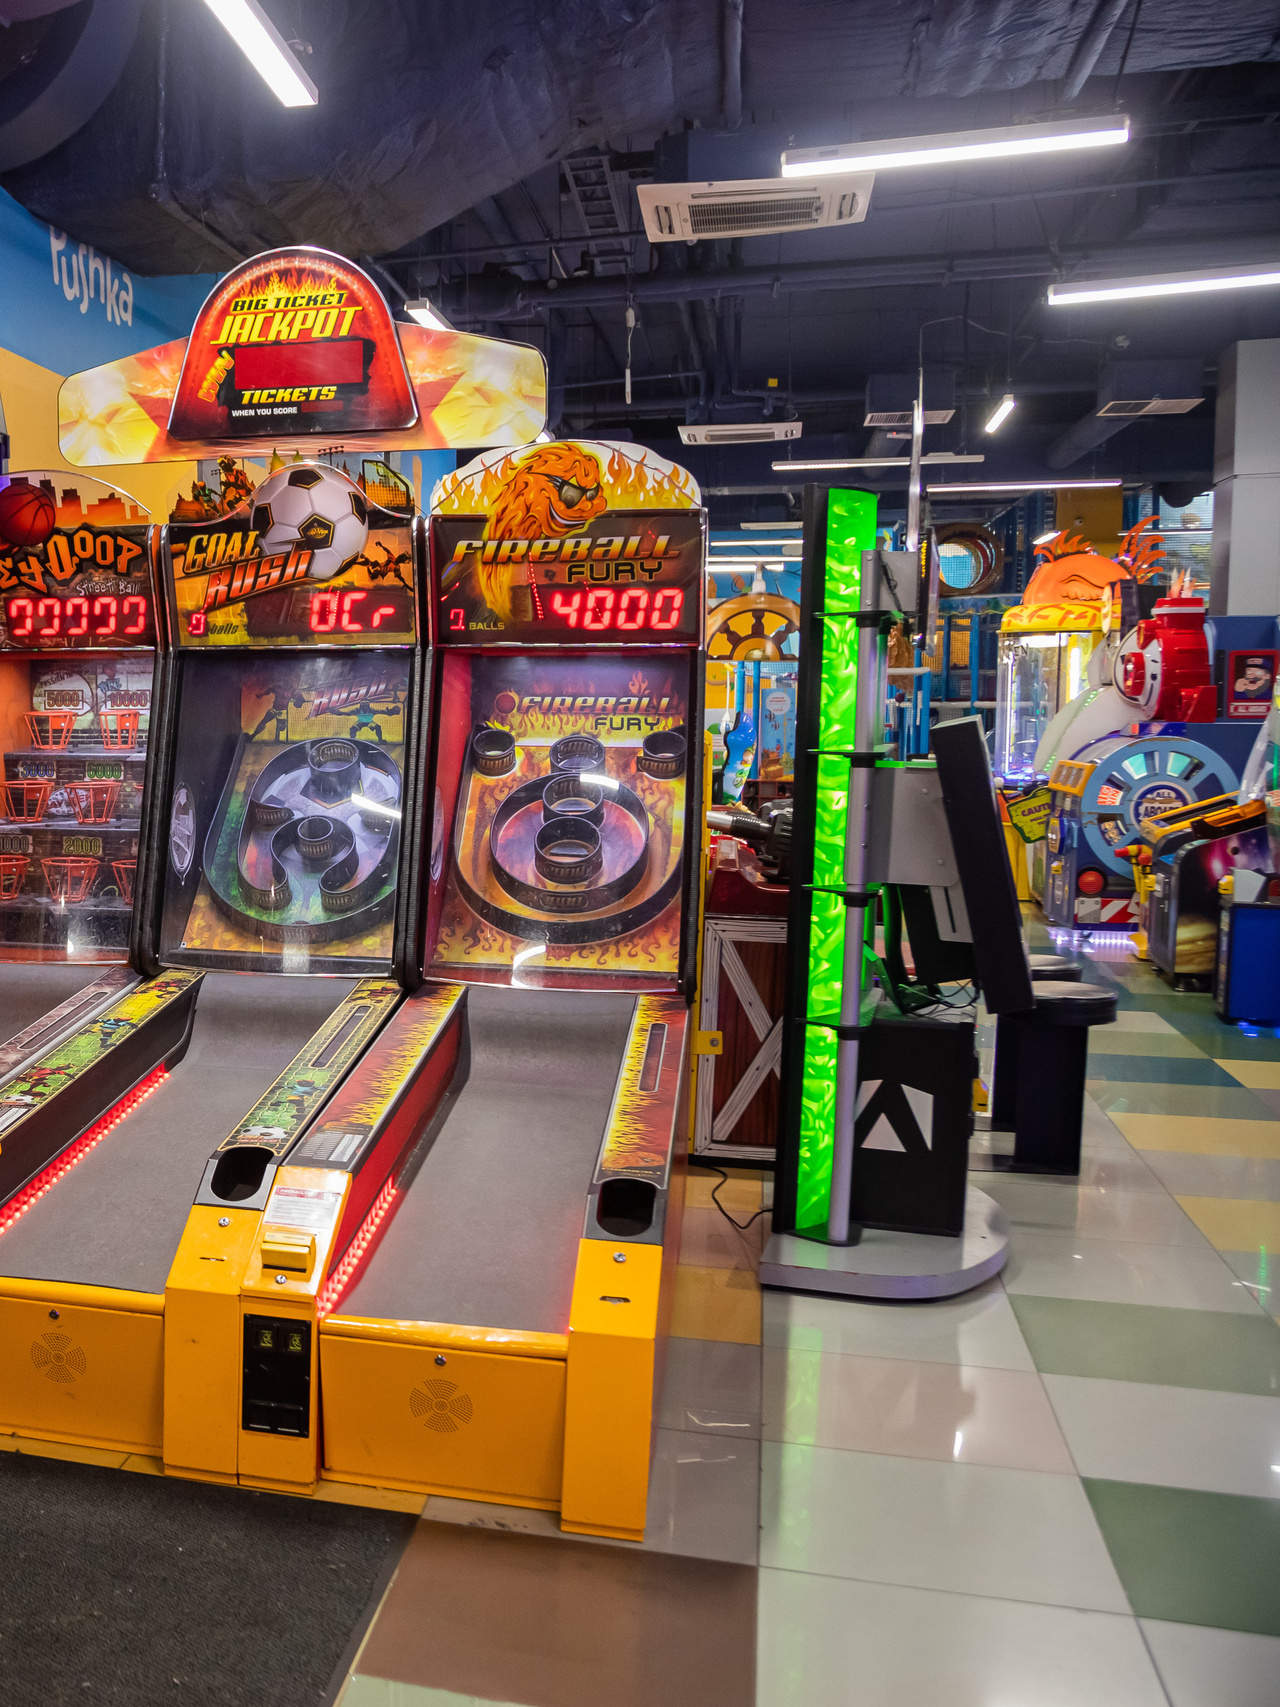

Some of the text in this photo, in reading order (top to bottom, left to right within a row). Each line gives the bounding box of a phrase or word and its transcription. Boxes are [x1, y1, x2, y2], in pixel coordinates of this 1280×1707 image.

[231, 292, 348, 312] BIG TICKET
[210, 306, 364, 345] JACKPOT
[197, 350, 235, 402] WIN
[241, 386, 337, 405] TICKETS
[231, 406, 298, 417] WHEN YOU SCORE
[183, 530, 262, 573] GOAL
[452, 535, 680, 564] FIREBALL
[204, 548, 314, 611] RUSH
[567, 561, 663, 583] FURY
[550, 588, 684, 630] 4000
[210, 623, 238, 635] balls
[469, 622, 505, 630] BALLS
[47, 691, 80, 708] 5000
[521, 696, 676, 715] FIREBALL
[594, 716, 661, 731] FURY
[20, 761, 55, 778] 3000
[64, 837, 101, 854] 2000
